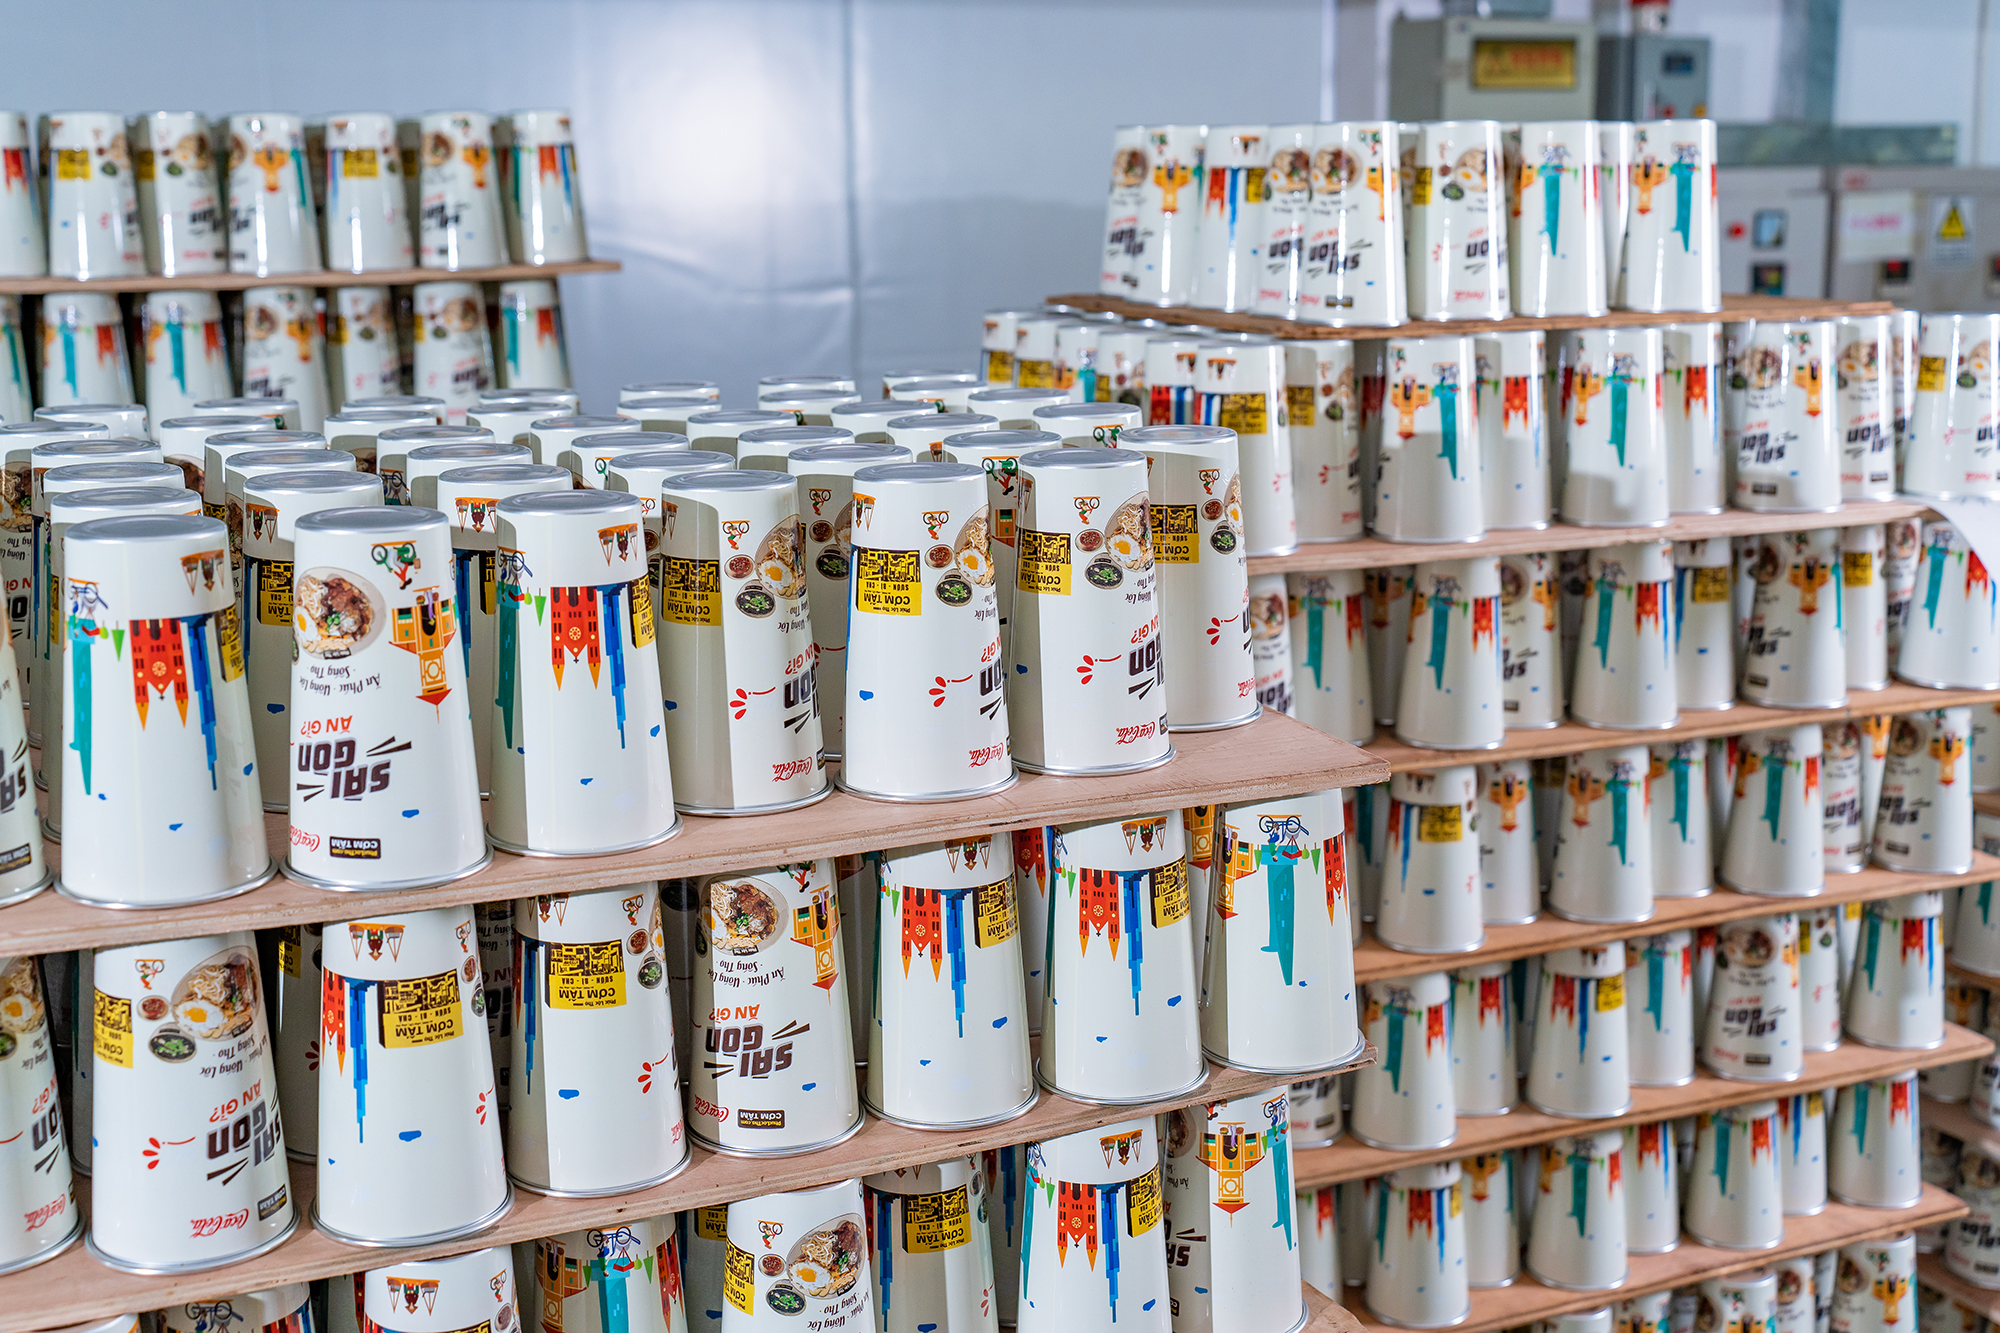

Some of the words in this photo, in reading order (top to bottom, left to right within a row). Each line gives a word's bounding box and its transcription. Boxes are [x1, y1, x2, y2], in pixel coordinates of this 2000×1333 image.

[1165, 546, 1189, 556] CƠM
[1021, 572, 1036, 584] TẤM
[1038, 575, 1060, 586] CƠM
[864, 593, 882, 605] TẤM
[885, 595, 910, 606] CƠM
[268, 605, 290, 618] TẤM
[668, 602, 684, 615] TẤM
[686, 605, 710, 616] CƠM
[328, 665, 350, 678] Sống
[310, 679, 330, 695] Uống
[339, 680, 363, 695] Phúc
[326, 715, 353, 734] ĂN
[1116, 721, 1156, 745] Coca-Cola
[772, 757, 812, 782] Coca-Cola
[331, 761, 390, 801] SÀI
[331, 838, 352, 849] TẤM
[353, 840, 378, 850] CƠM
[988, 924, 1005, 937] TẤM
[737, 960, 758, 973] Sống
[719, 972, 740, 988] Uống
[748, 972, 769, 987] Phúc
[771, 967, 785, 980] Ăn
[559, 990, 584, 1002] TẤM
[587, 987, 615, 999] CƠM
[735, 1004, 760, 1021] ĂN
[395, 1026, 423, 1039] TẤM
[426, 1019, 453, 1033] CƠM
[220, 1060, 243, 1074] Uống
[739, 1042, 792, 1079] SÀI
[243, 1078, 261, 1106] ĂN
[740, 1111, 759, 1120] TẤM
[760, 1112, 782, 1120] CƠM
[189, 1208, 249, 1238] Coca-Cola
[706, 1222, 726, 1234] TẤM
[916, 1234, 939, 1245] TẤM
[942, 1228, 964, 1240] CƠM
[824, 1315, 846, 1329] Uống
